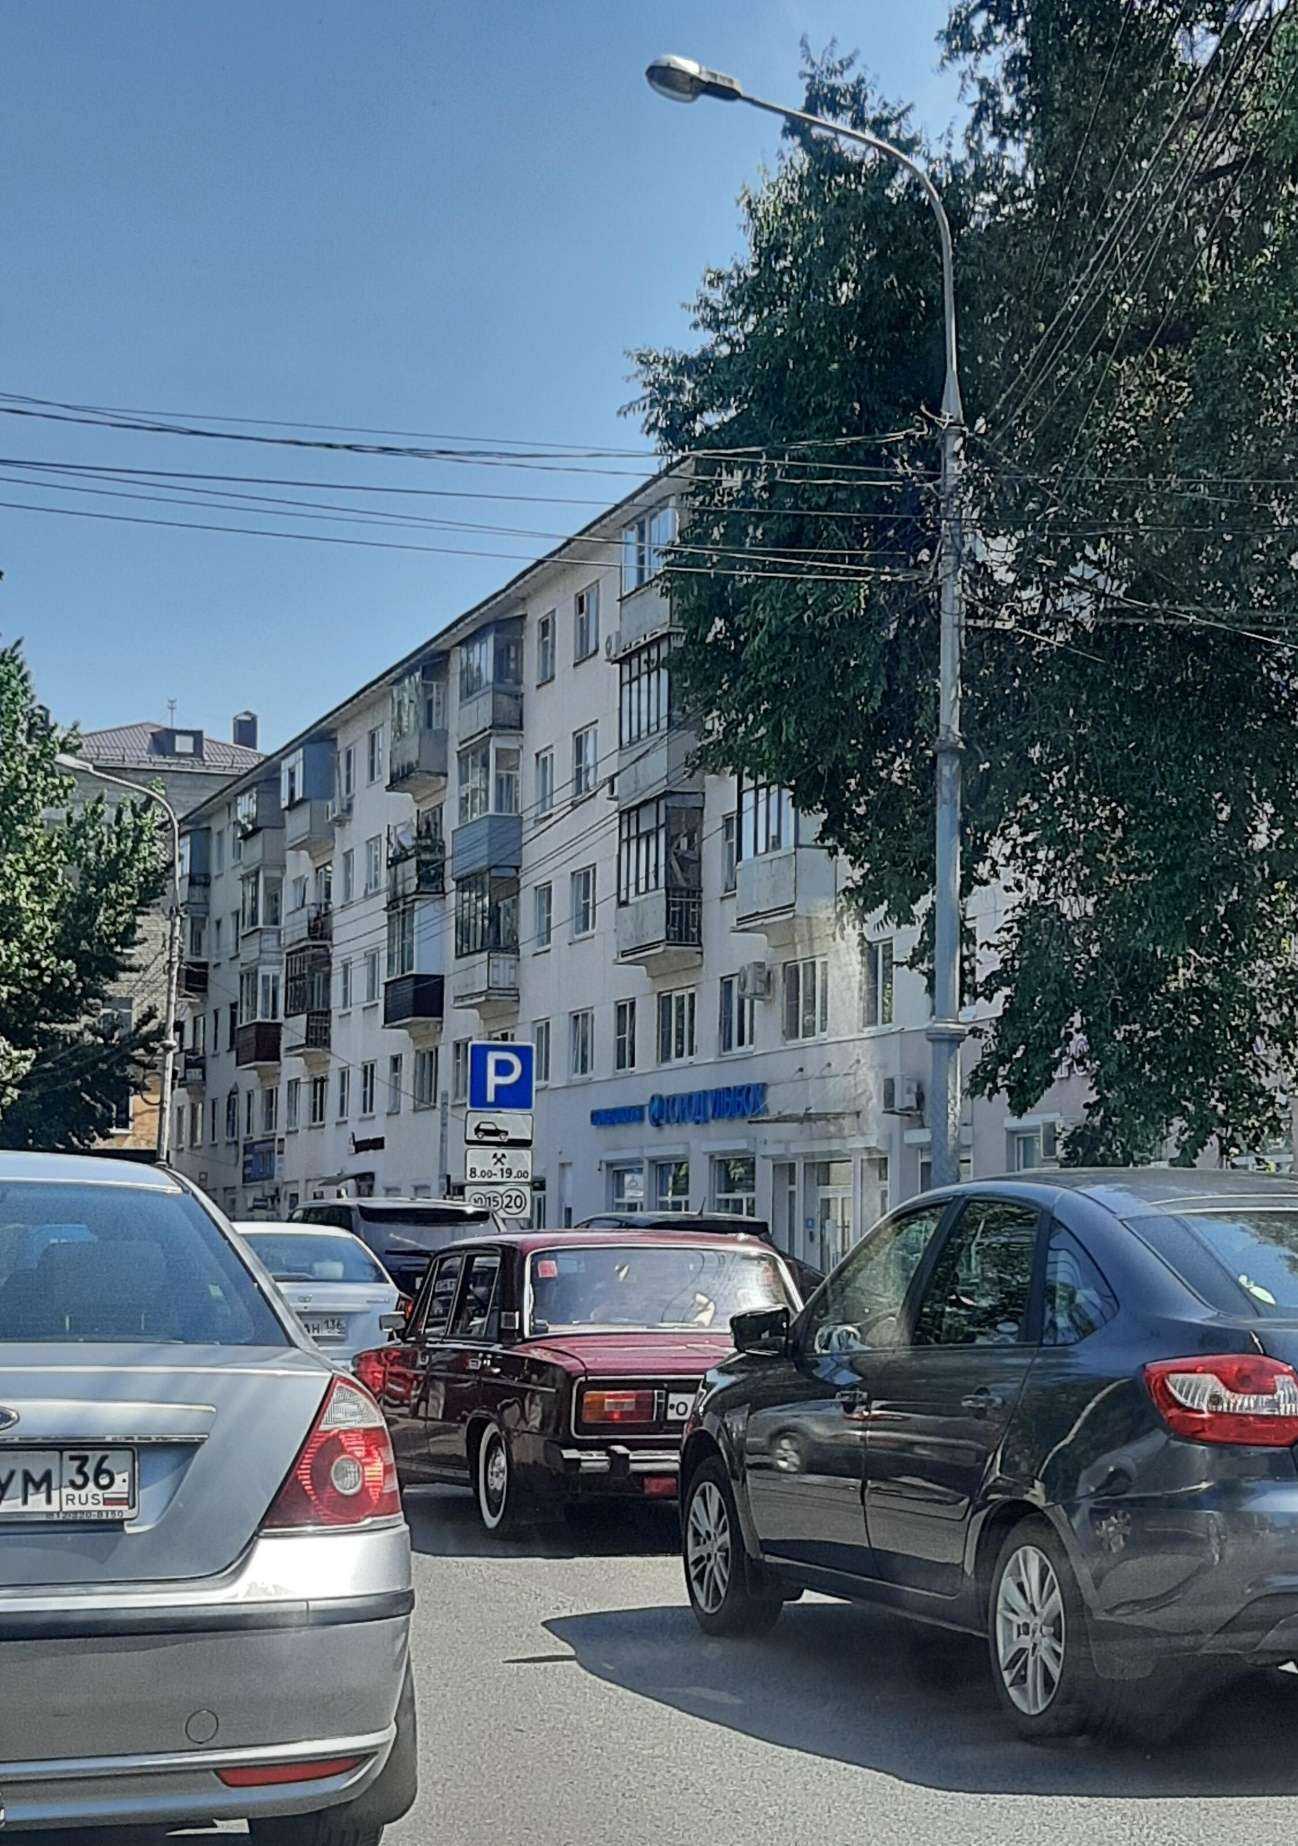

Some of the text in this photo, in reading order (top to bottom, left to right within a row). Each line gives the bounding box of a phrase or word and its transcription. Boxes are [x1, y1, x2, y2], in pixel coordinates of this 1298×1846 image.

[486, 1050, 522, 1103] P
[486, 1195, 500, 1208] 15
[504, 1194, 523, 1209] 20
[68, 1454, 115, 1490] 36
[65, 1493, 101, 1505] RUS
